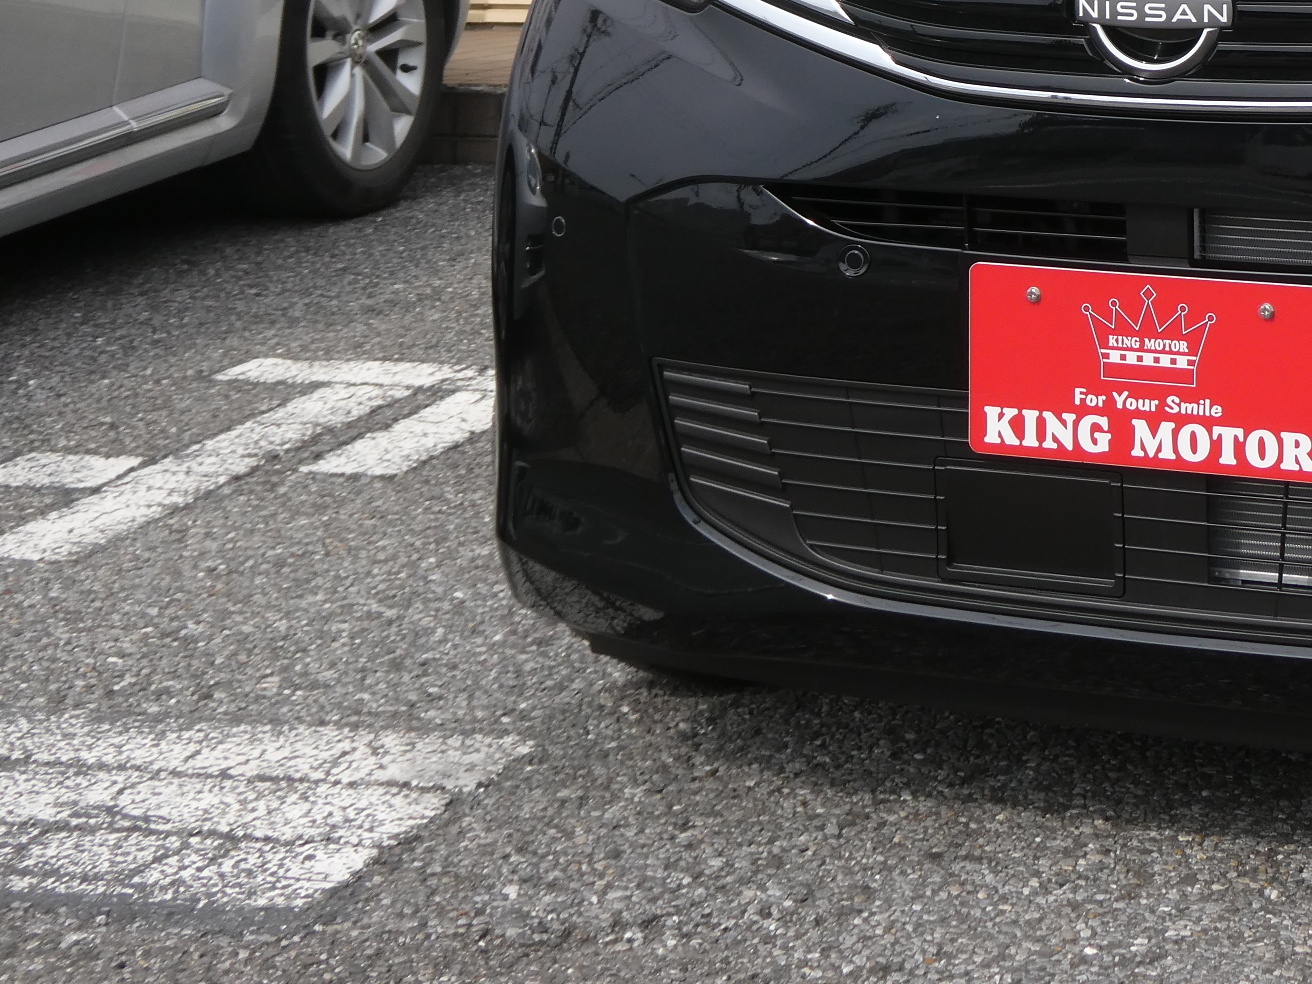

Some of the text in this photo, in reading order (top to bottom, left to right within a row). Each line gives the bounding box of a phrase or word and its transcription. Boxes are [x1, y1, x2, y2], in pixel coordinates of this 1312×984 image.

[1108, 335, 1189, 353] KING MOTOR
[1074, 387, 1223, 418] For Your Smile
[983, 405, 1112, 454] KING
